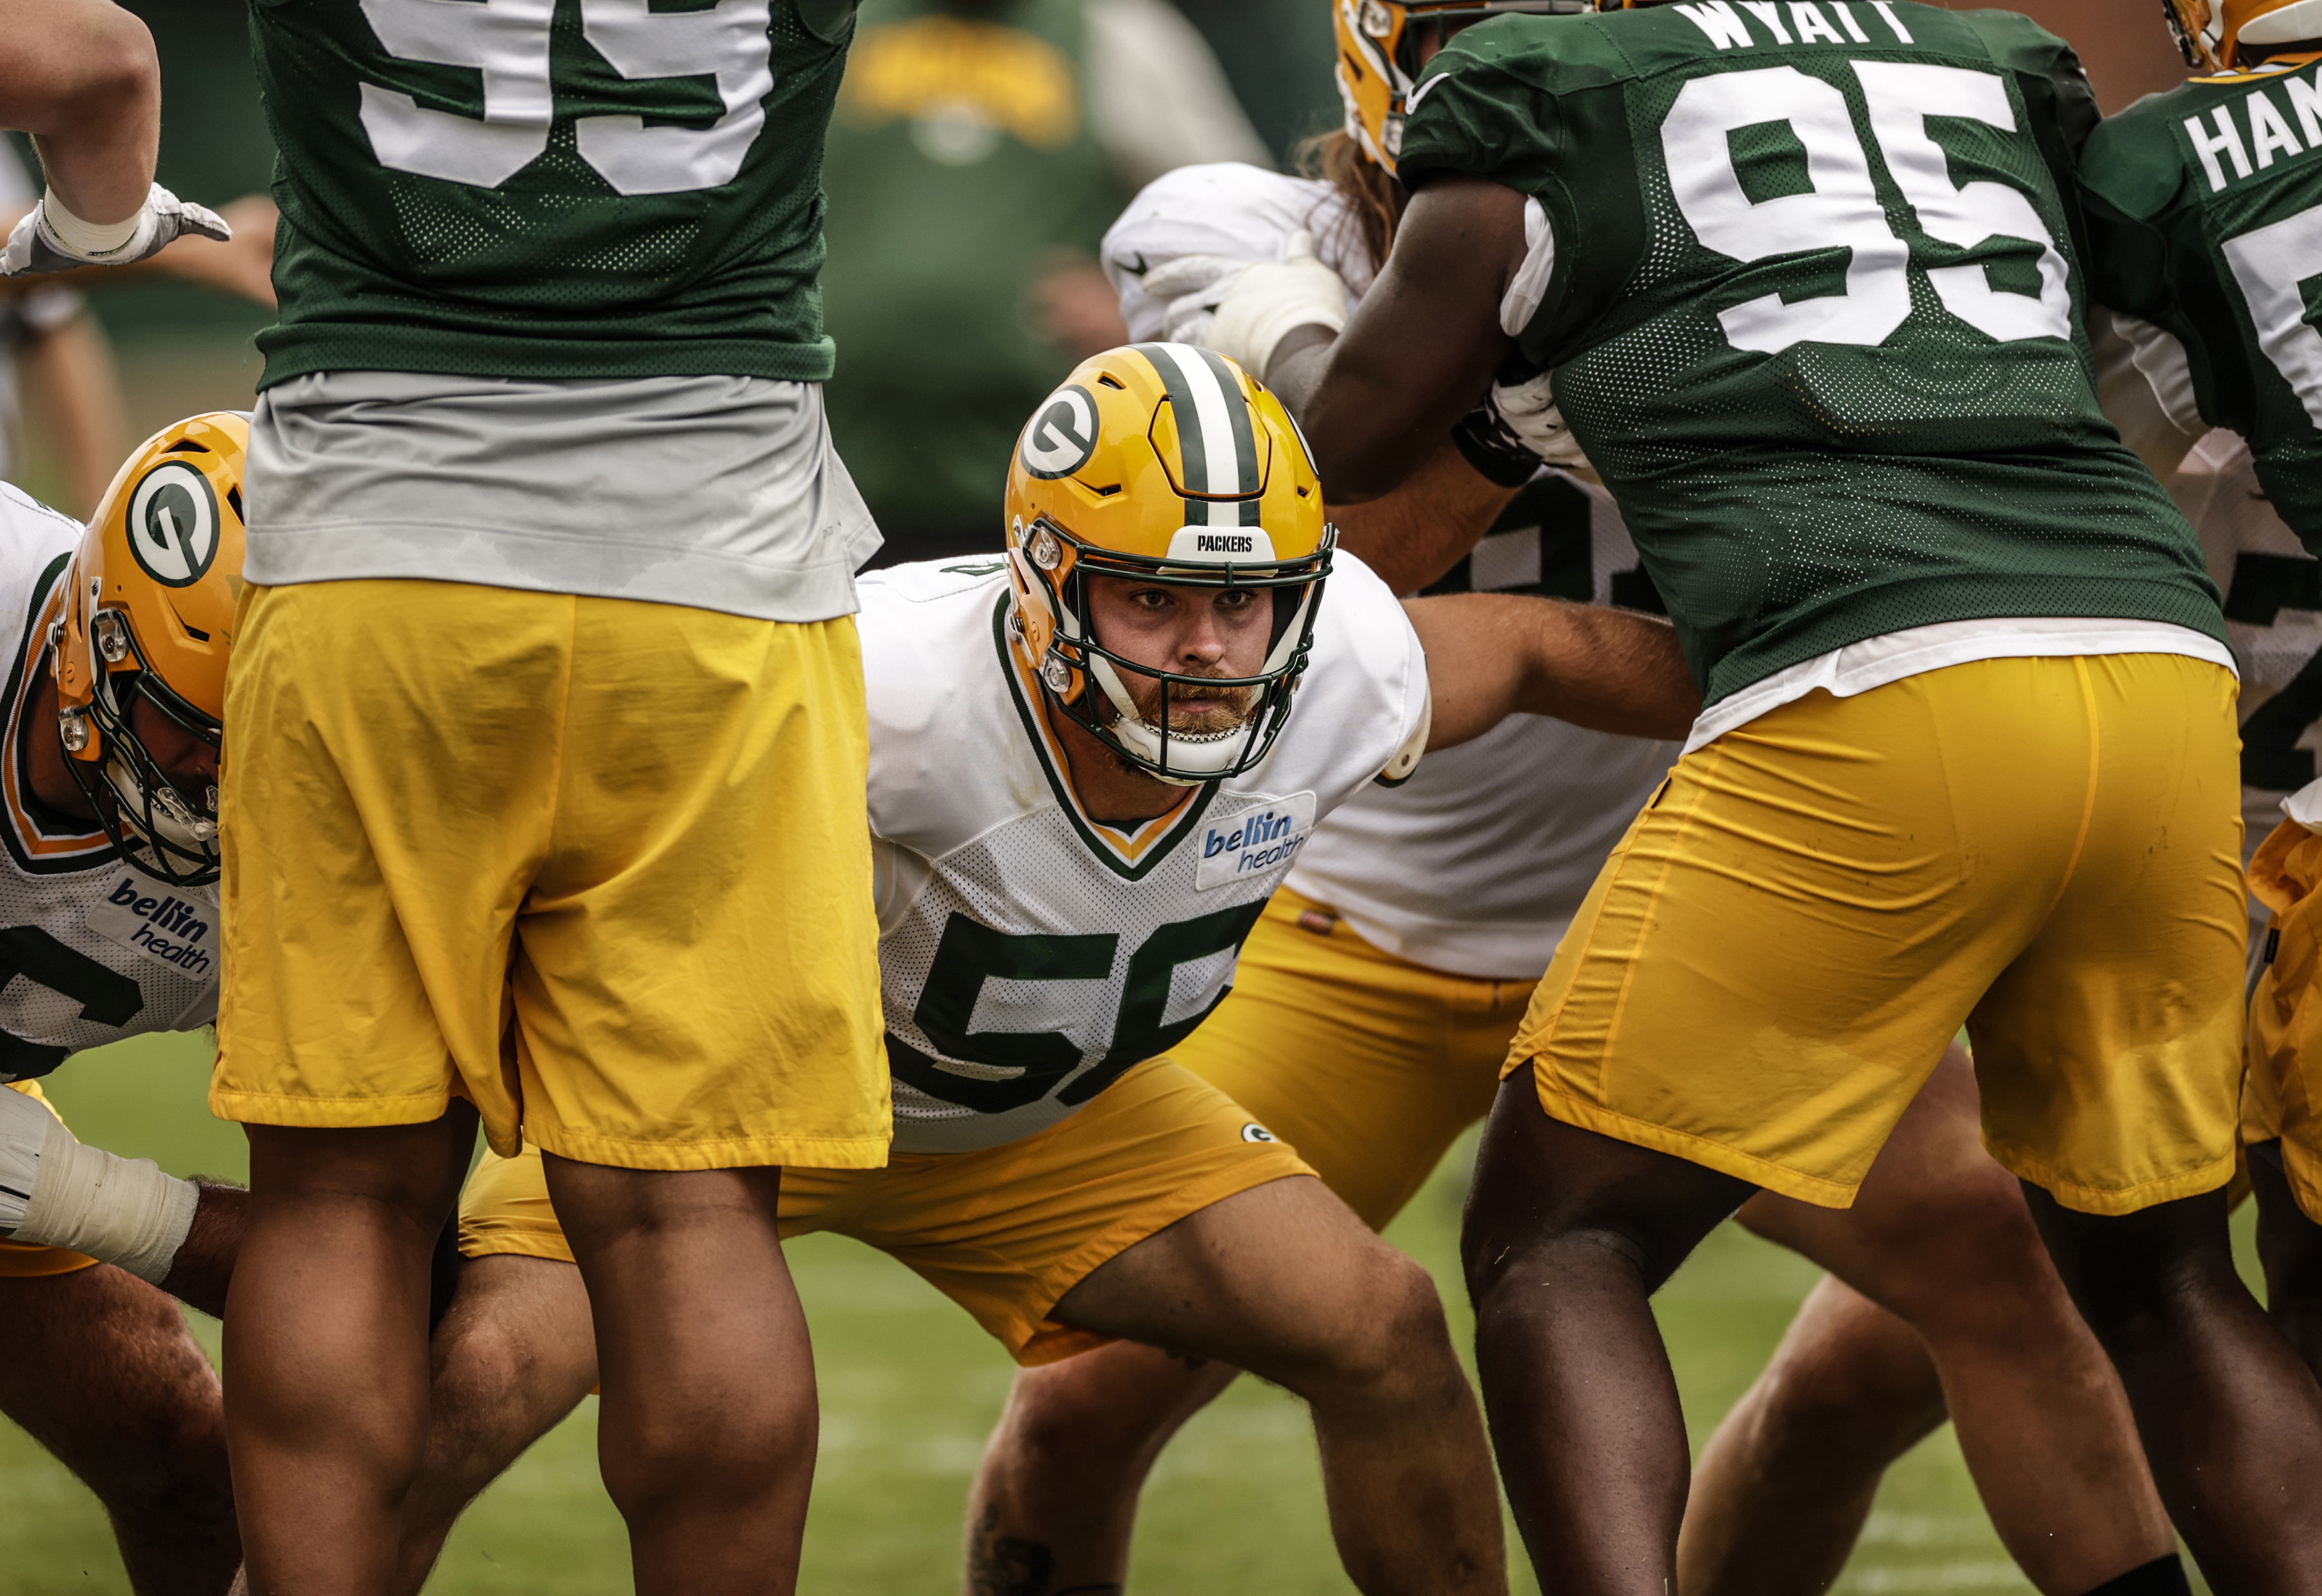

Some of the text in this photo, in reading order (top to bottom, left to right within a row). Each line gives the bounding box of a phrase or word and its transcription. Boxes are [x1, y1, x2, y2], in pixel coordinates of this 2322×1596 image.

[1660, 59, 2071, 355] 95
[1197, 535, 1252, 553] PACKERS
[1204, 811, 1293, 858] bellin
[1237, 833, 1304, 873] health
[108, 878, 208, 943] bellin
[130, 922, 210, 974] health
